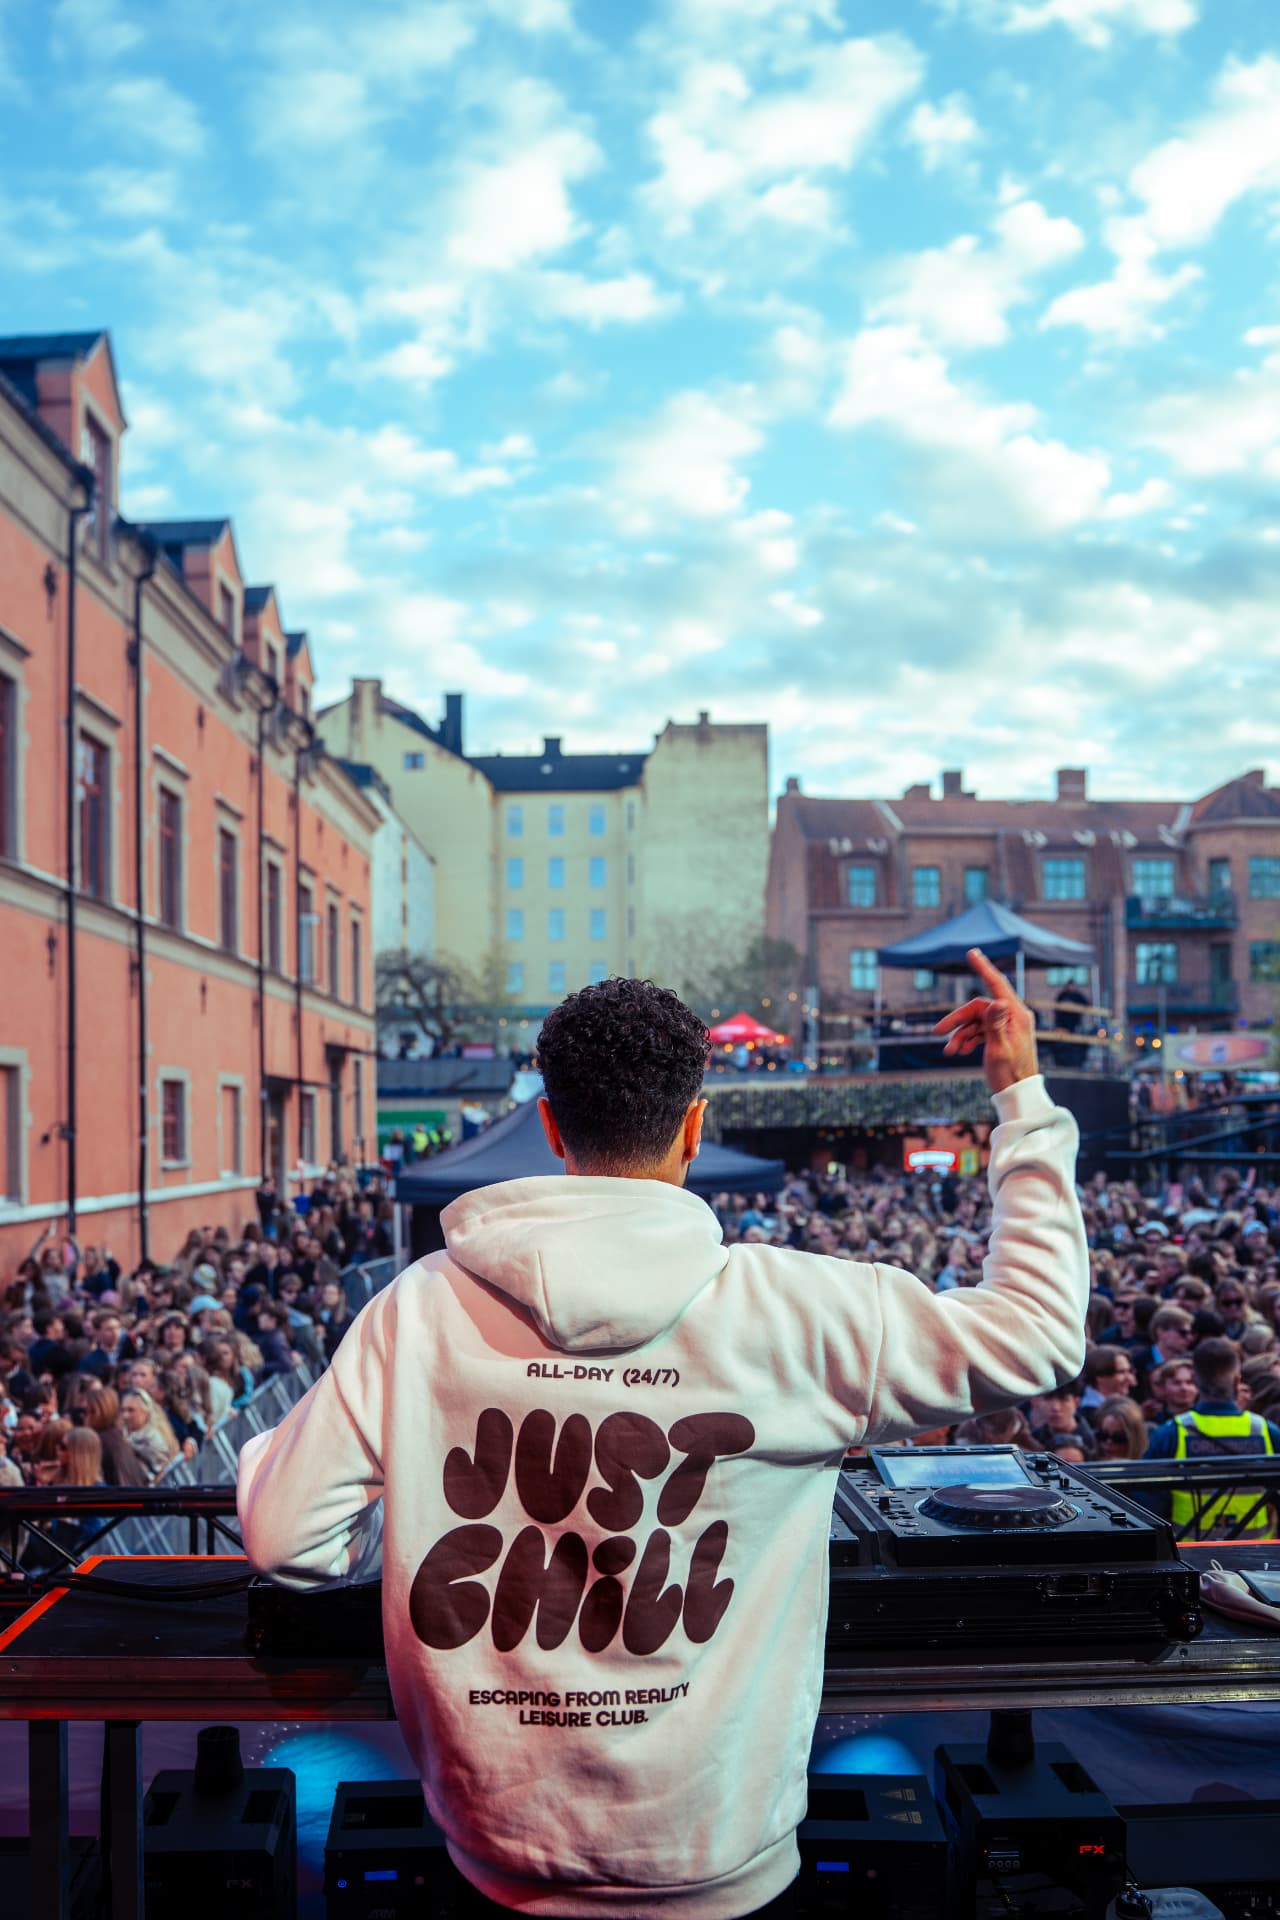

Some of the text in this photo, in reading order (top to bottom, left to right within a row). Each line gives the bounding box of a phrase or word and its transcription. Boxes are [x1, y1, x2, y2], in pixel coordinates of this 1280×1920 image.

[527, 1362, 680, 1387] ALL-DAY (24/7)
[443, 1407, 755, 1532] JUST
[468, 1682, 690, 1707] ESCAPING FROM REALITY
[519, 1710, 649, 1727] LEISURE CLUB.
[1079, 1845, 1105, 1854] FX
